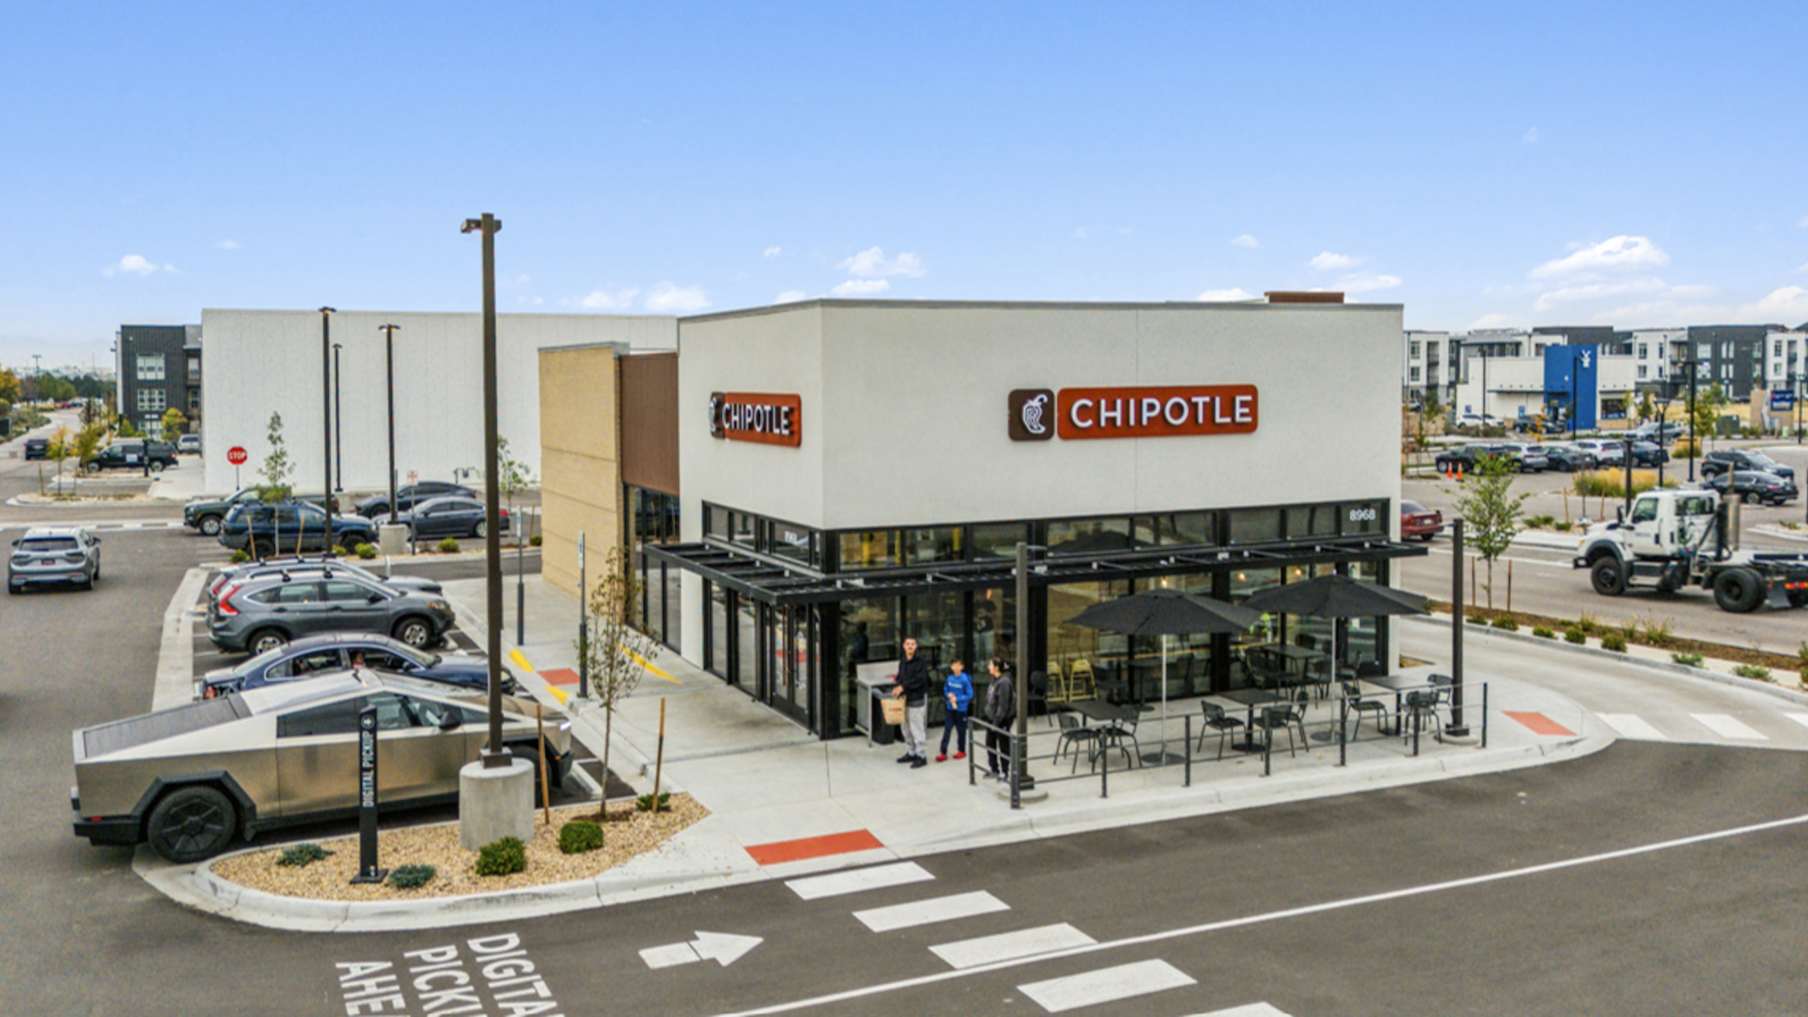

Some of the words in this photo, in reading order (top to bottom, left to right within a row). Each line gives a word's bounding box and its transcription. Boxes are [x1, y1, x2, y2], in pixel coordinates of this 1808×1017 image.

[722, 403, 790, 435] CHIPOTLE
[1071, 395, 1253, 428] CHIPOTLE
[229, 451, 247, 460] STOP
[1350, 508, 1376, 521] 8968
[362, 731, 375, 768] PICKUP
[362, 770, 375, 807] DIGITAL
[335, 961, 411, 1017] AHE
[467, 932, 565, 1017] DIGITA
